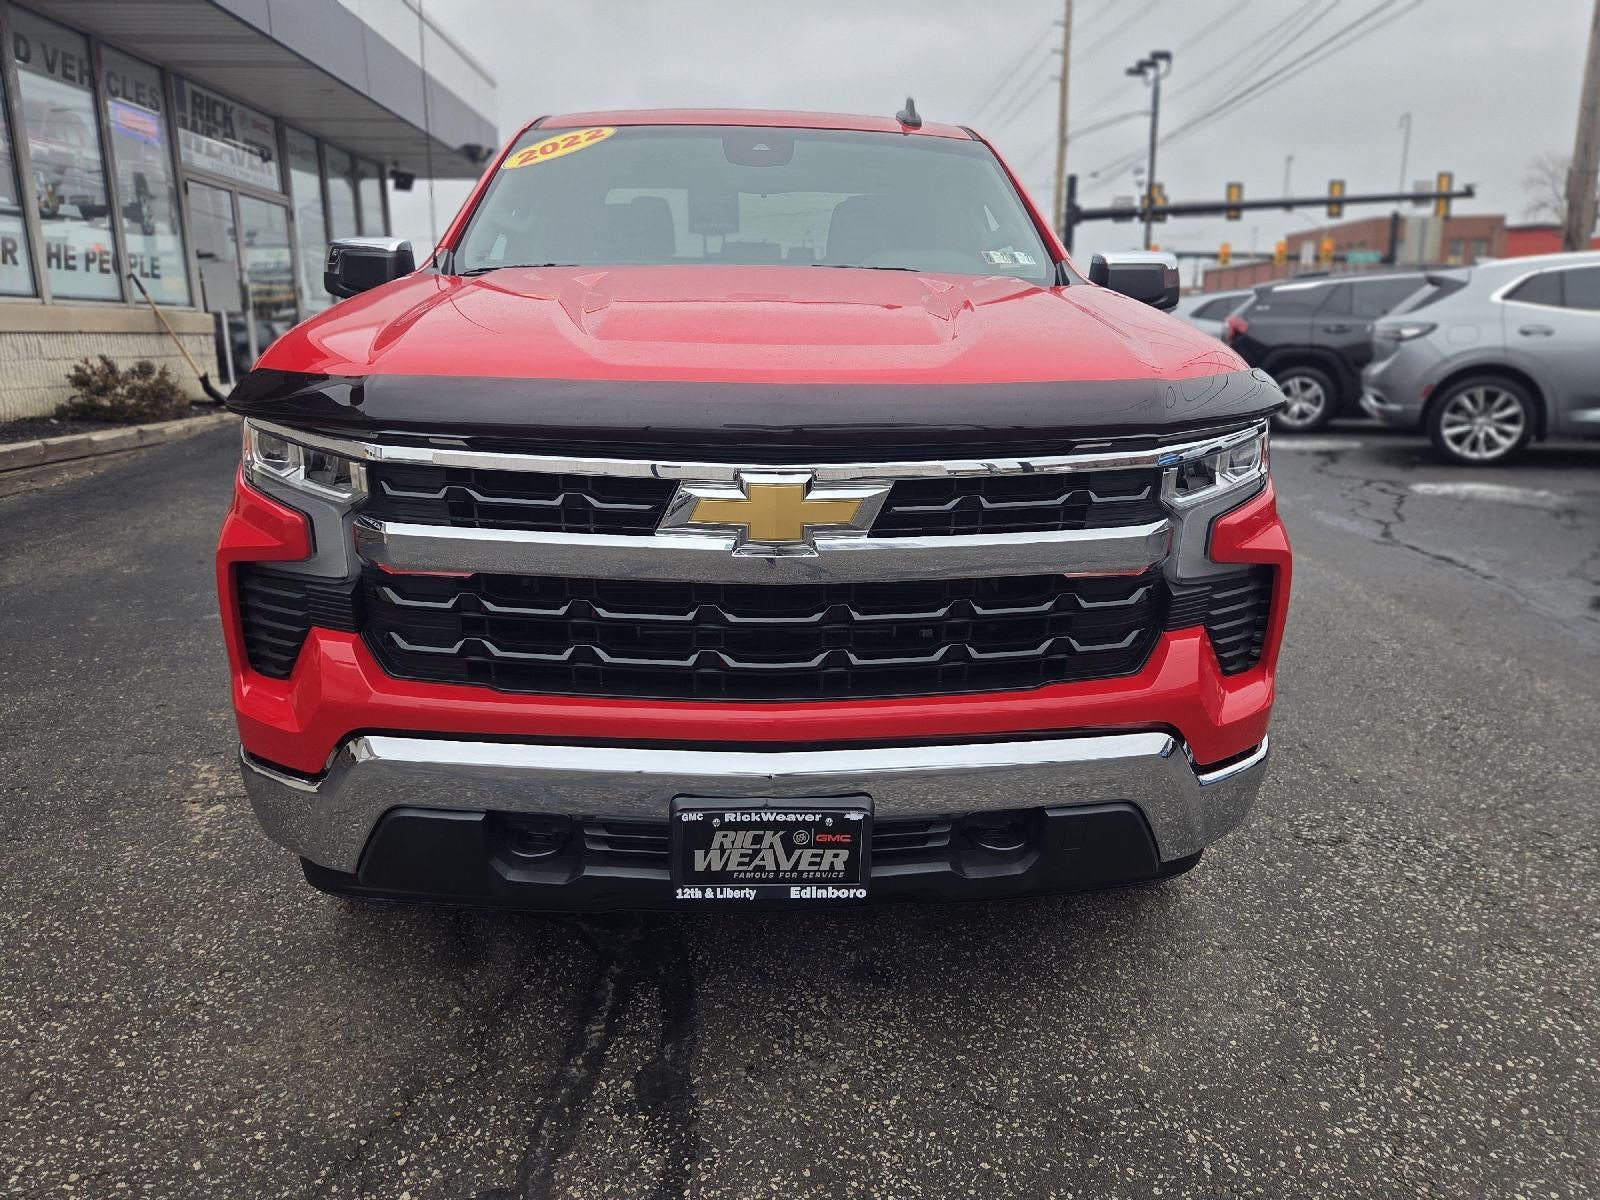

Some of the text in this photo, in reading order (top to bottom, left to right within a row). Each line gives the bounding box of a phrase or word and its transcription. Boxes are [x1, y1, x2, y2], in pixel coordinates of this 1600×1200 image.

[41, 42, 161, 112] VEHCLES
[517, 128, 605, 165] 2022
[46, 242, 78, 271] HE
[681, 812, 823, 822] GMC RickWeaver
[710, 830, 788, 850] RICK
[815, 834, 853, 843] GMC
[693, 849, 850, 872] WEAVER
[802, 871, 846, 879] SERVICE
[676, 887, 758, 900] 12th & Liberty
[790, 886, 867, 899] Edinboro
